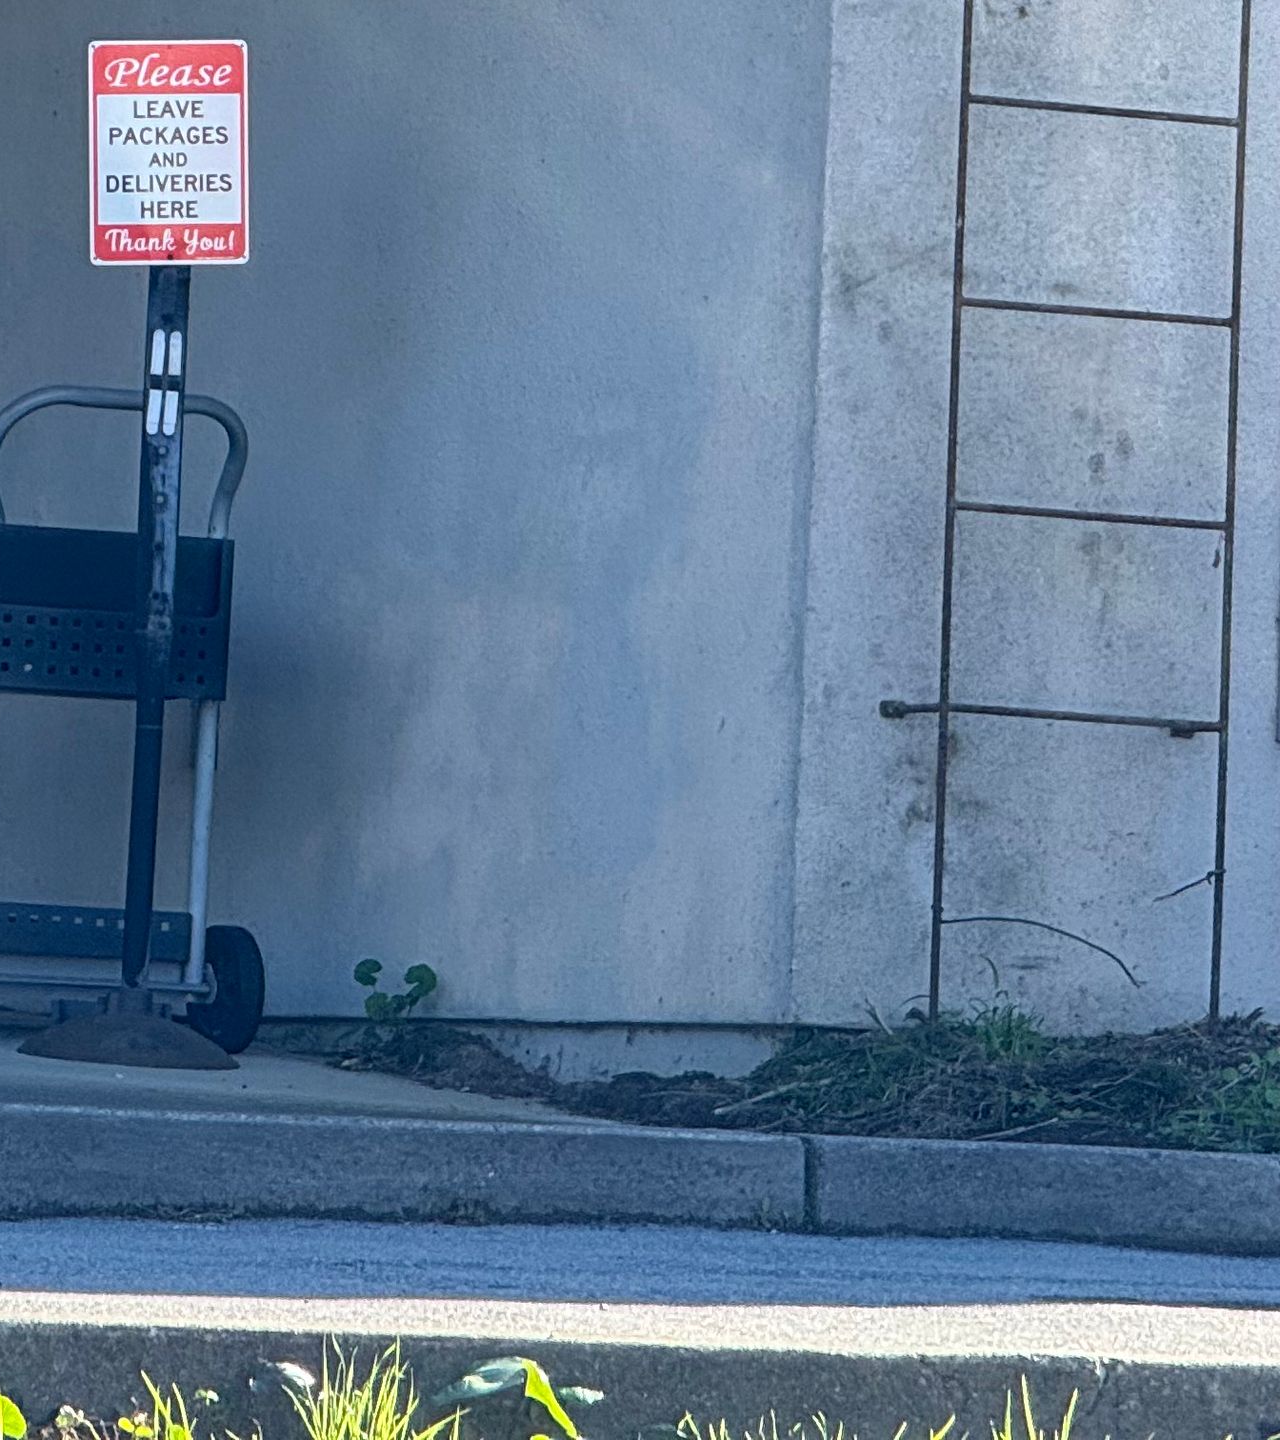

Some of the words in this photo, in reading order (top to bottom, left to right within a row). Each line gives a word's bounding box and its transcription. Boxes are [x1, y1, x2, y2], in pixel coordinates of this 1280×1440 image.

[104, 52, 233, 88] Please
[133, 100, 205, 119] LEAVE
[108, 126, 229, 146] PACKAGES
[148, 152, 188, 168] AND
[105, 173, 233, 194] DELIVERIES
[140, 200, 200, 219] HERE
[104, 228, 177, 253] Thank
[183, 229, 235, 255] You!
